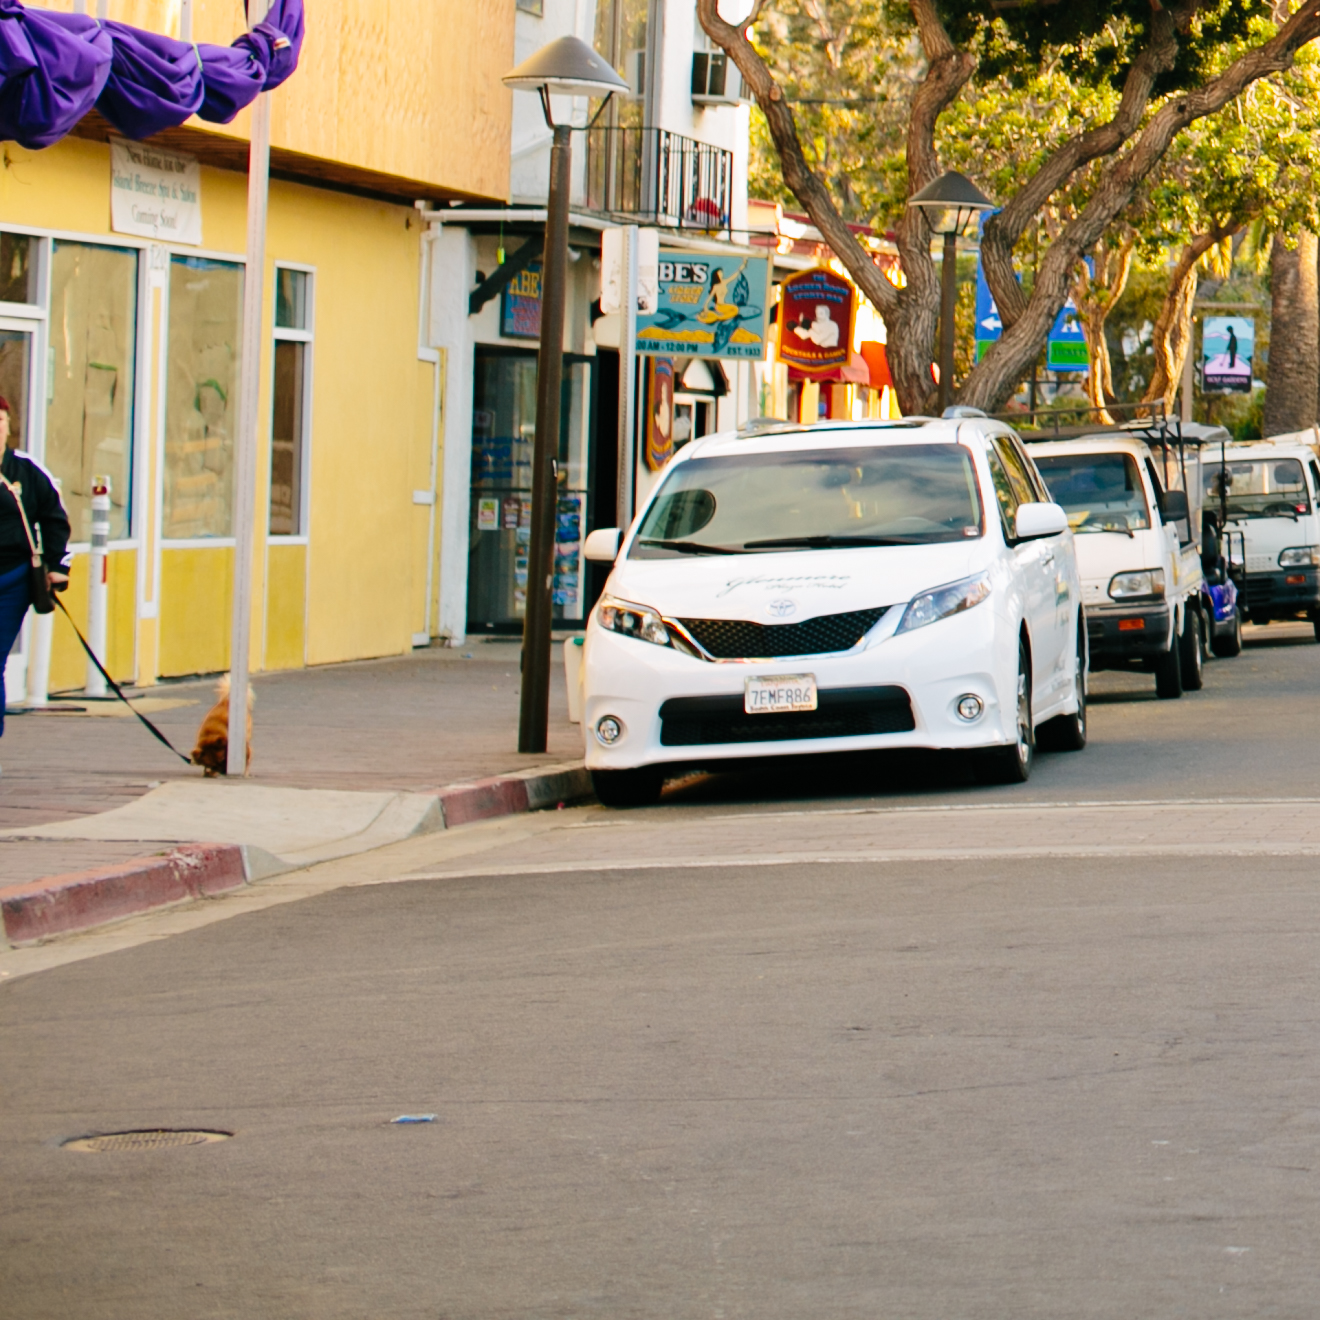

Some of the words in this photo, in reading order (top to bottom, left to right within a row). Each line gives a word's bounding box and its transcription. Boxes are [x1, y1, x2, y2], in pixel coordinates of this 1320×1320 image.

[134, 173, 156, 196] Breeze
[658, 262, 709, 284] BE'S
[509, 270, 541, 299] ABE
[647, 341, 660, 351] AM
[686, 344, 699, 353] PM
[751, 686, 812, 706] 7EMF886
